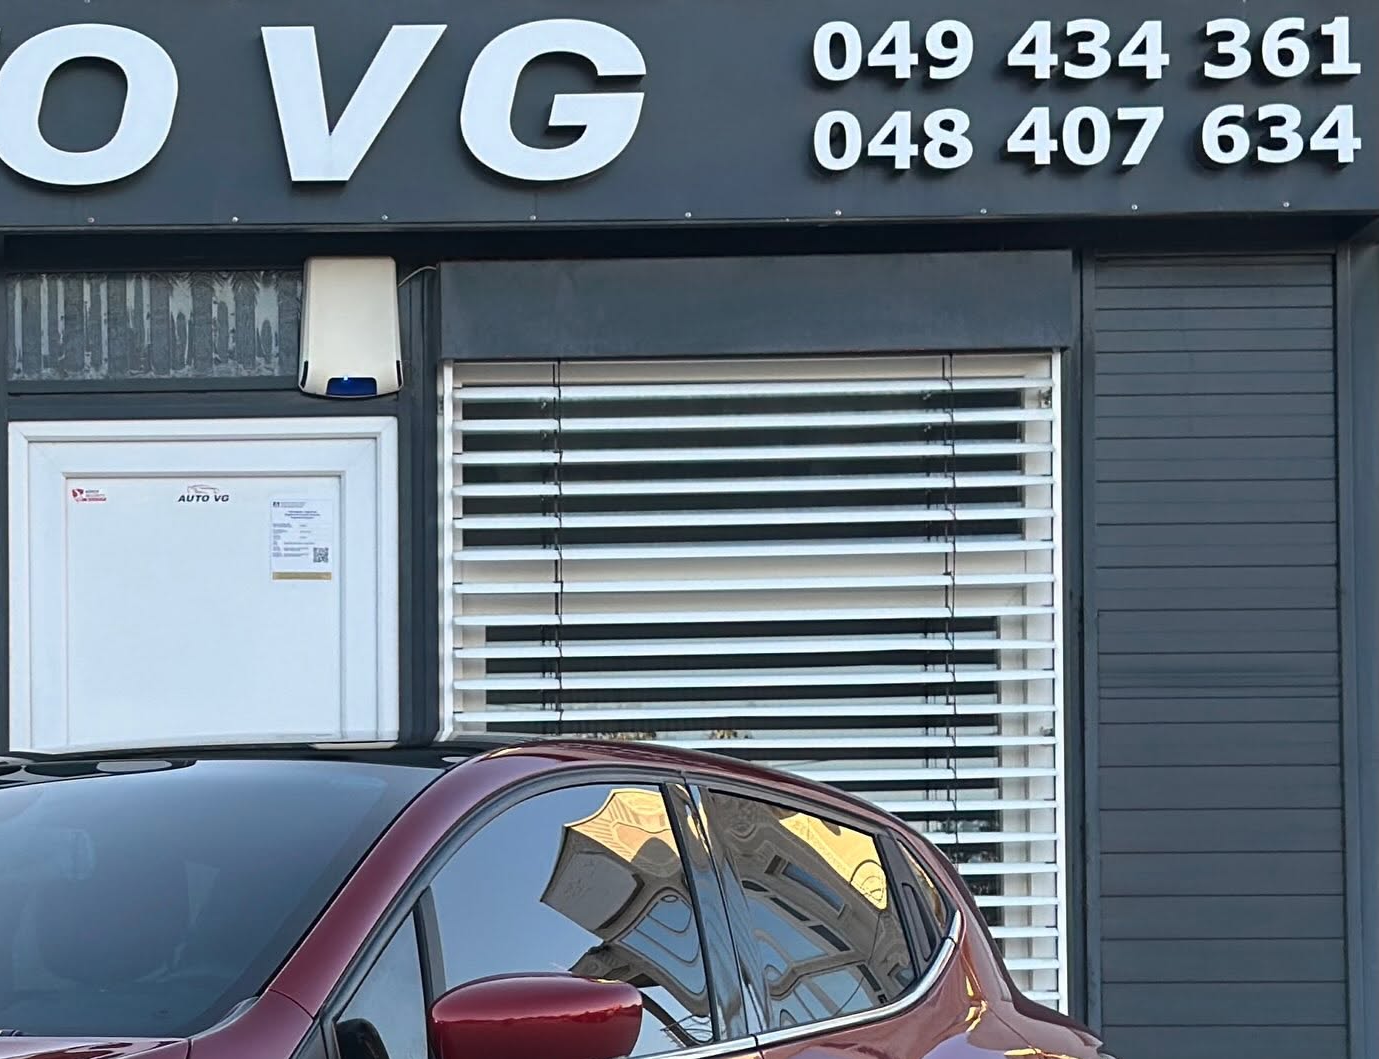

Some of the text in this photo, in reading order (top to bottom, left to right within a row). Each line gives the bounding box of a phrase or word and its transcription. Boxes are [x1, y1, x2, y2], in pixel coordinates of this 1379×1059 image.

[814, 16, 1362, 81] 049 434 361
[261, 19, 647, 182] VG
[814, 104, 1362, 171] 048 407 634
[178, 494, 230, 503] AUTO VG
